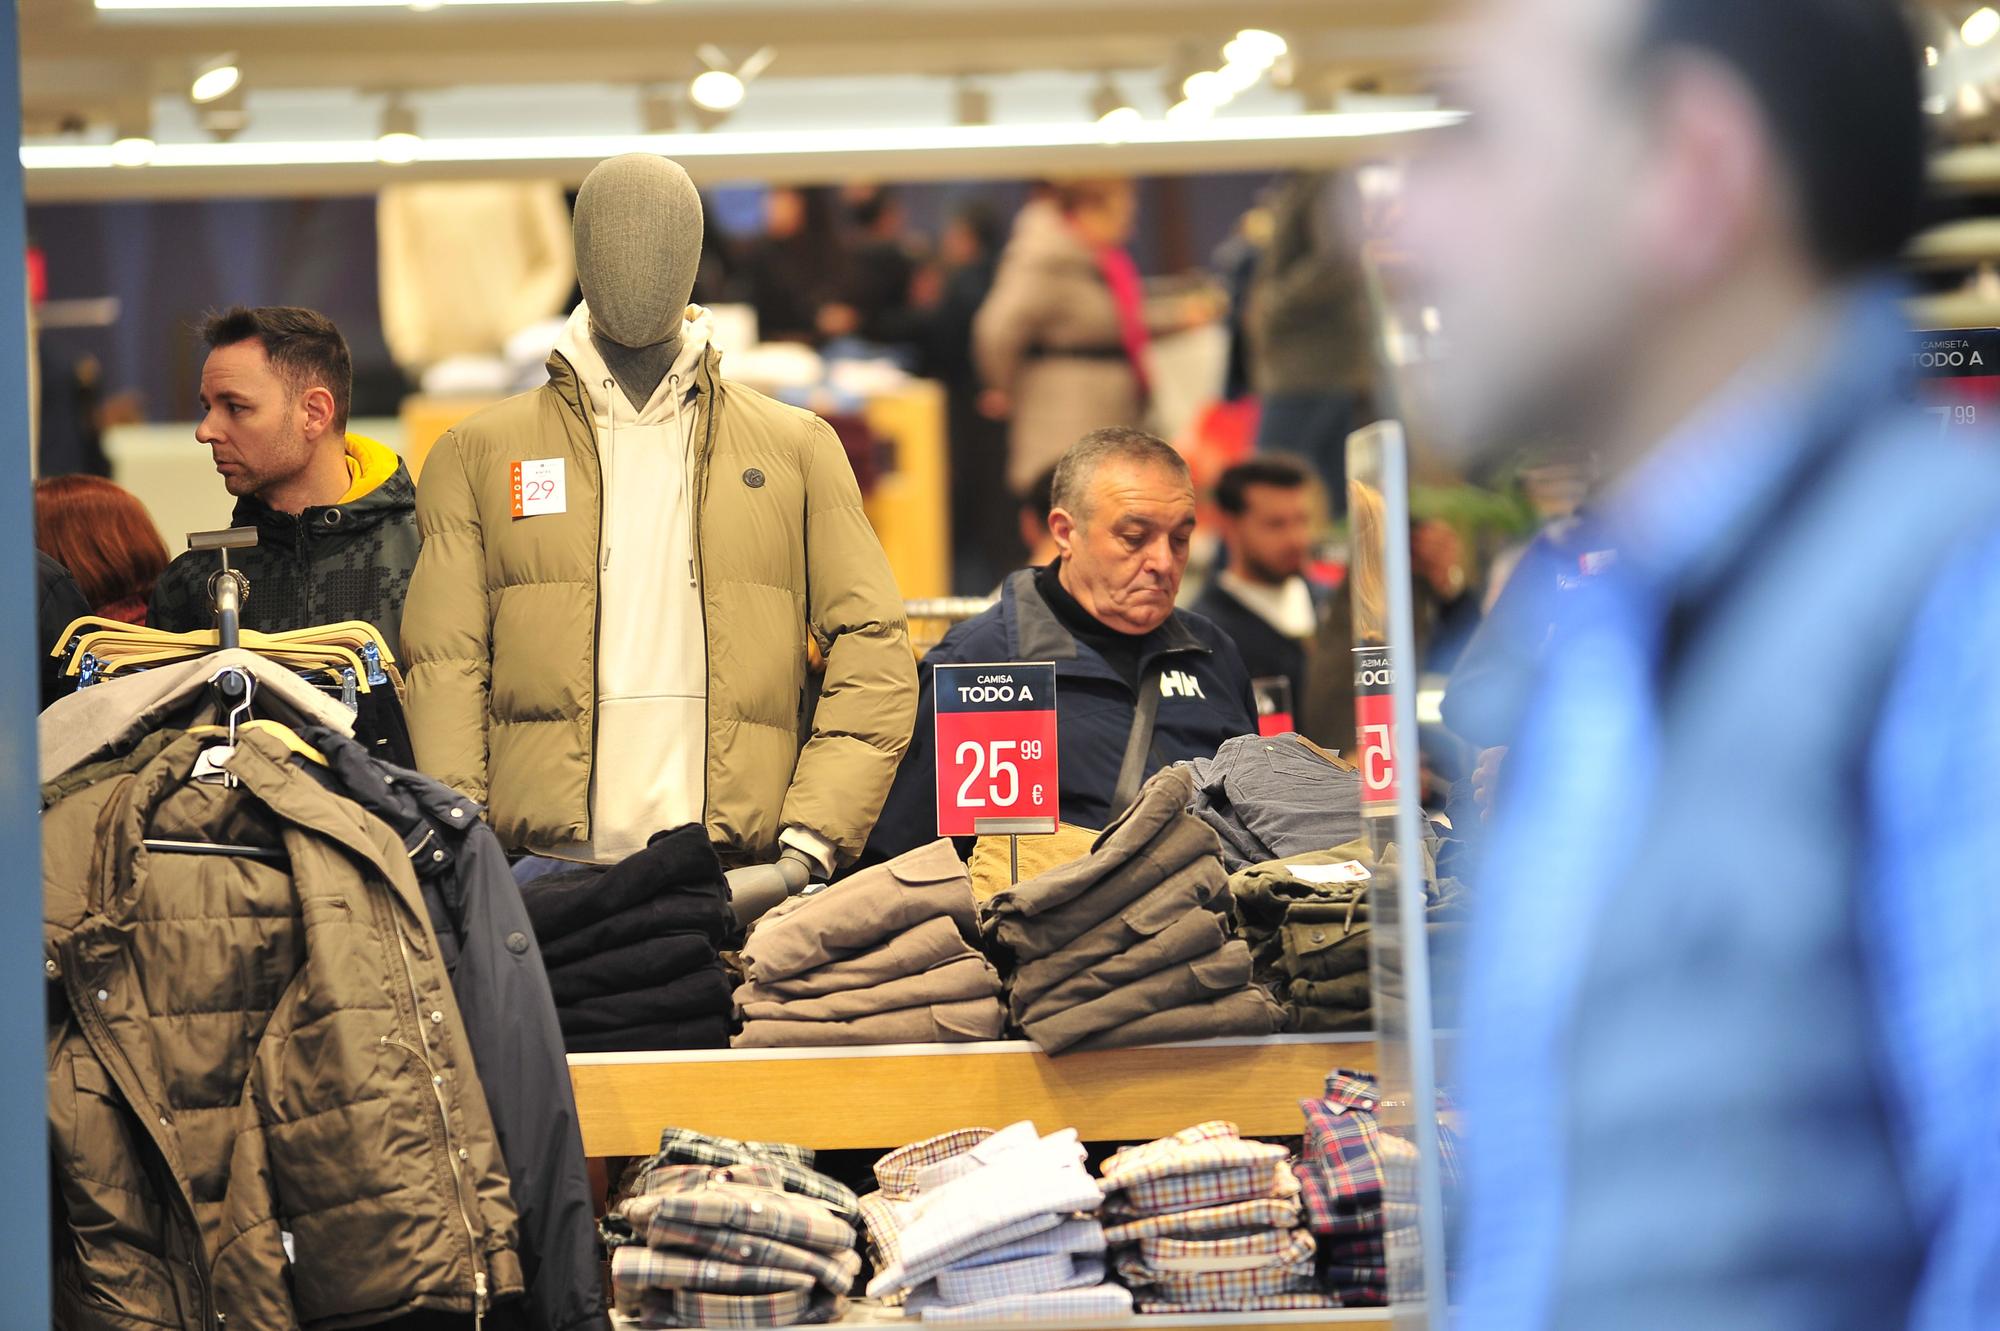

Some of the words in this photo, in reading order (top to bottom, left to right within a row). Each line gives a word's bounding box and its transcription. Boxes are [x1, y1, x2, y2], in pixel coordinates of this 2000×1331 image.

[1921, 339, 1969, 349] CAMISETA
[1911, 351, 1964, 368] TODO
[1969, 350, 1984, 366] A
[1955, 405, 1976, 425] 99
[526, 480, 555, 501] 29
[977, 675, 1013, 684] CAMISA
[958, 685, 1015, 703] TODO
[1018, 685, 1034, 702] A
[955, 740, 1020, 808] 25
[1020, 739, 1042, 760] 99
[1032, 784, 1044, 806] €
